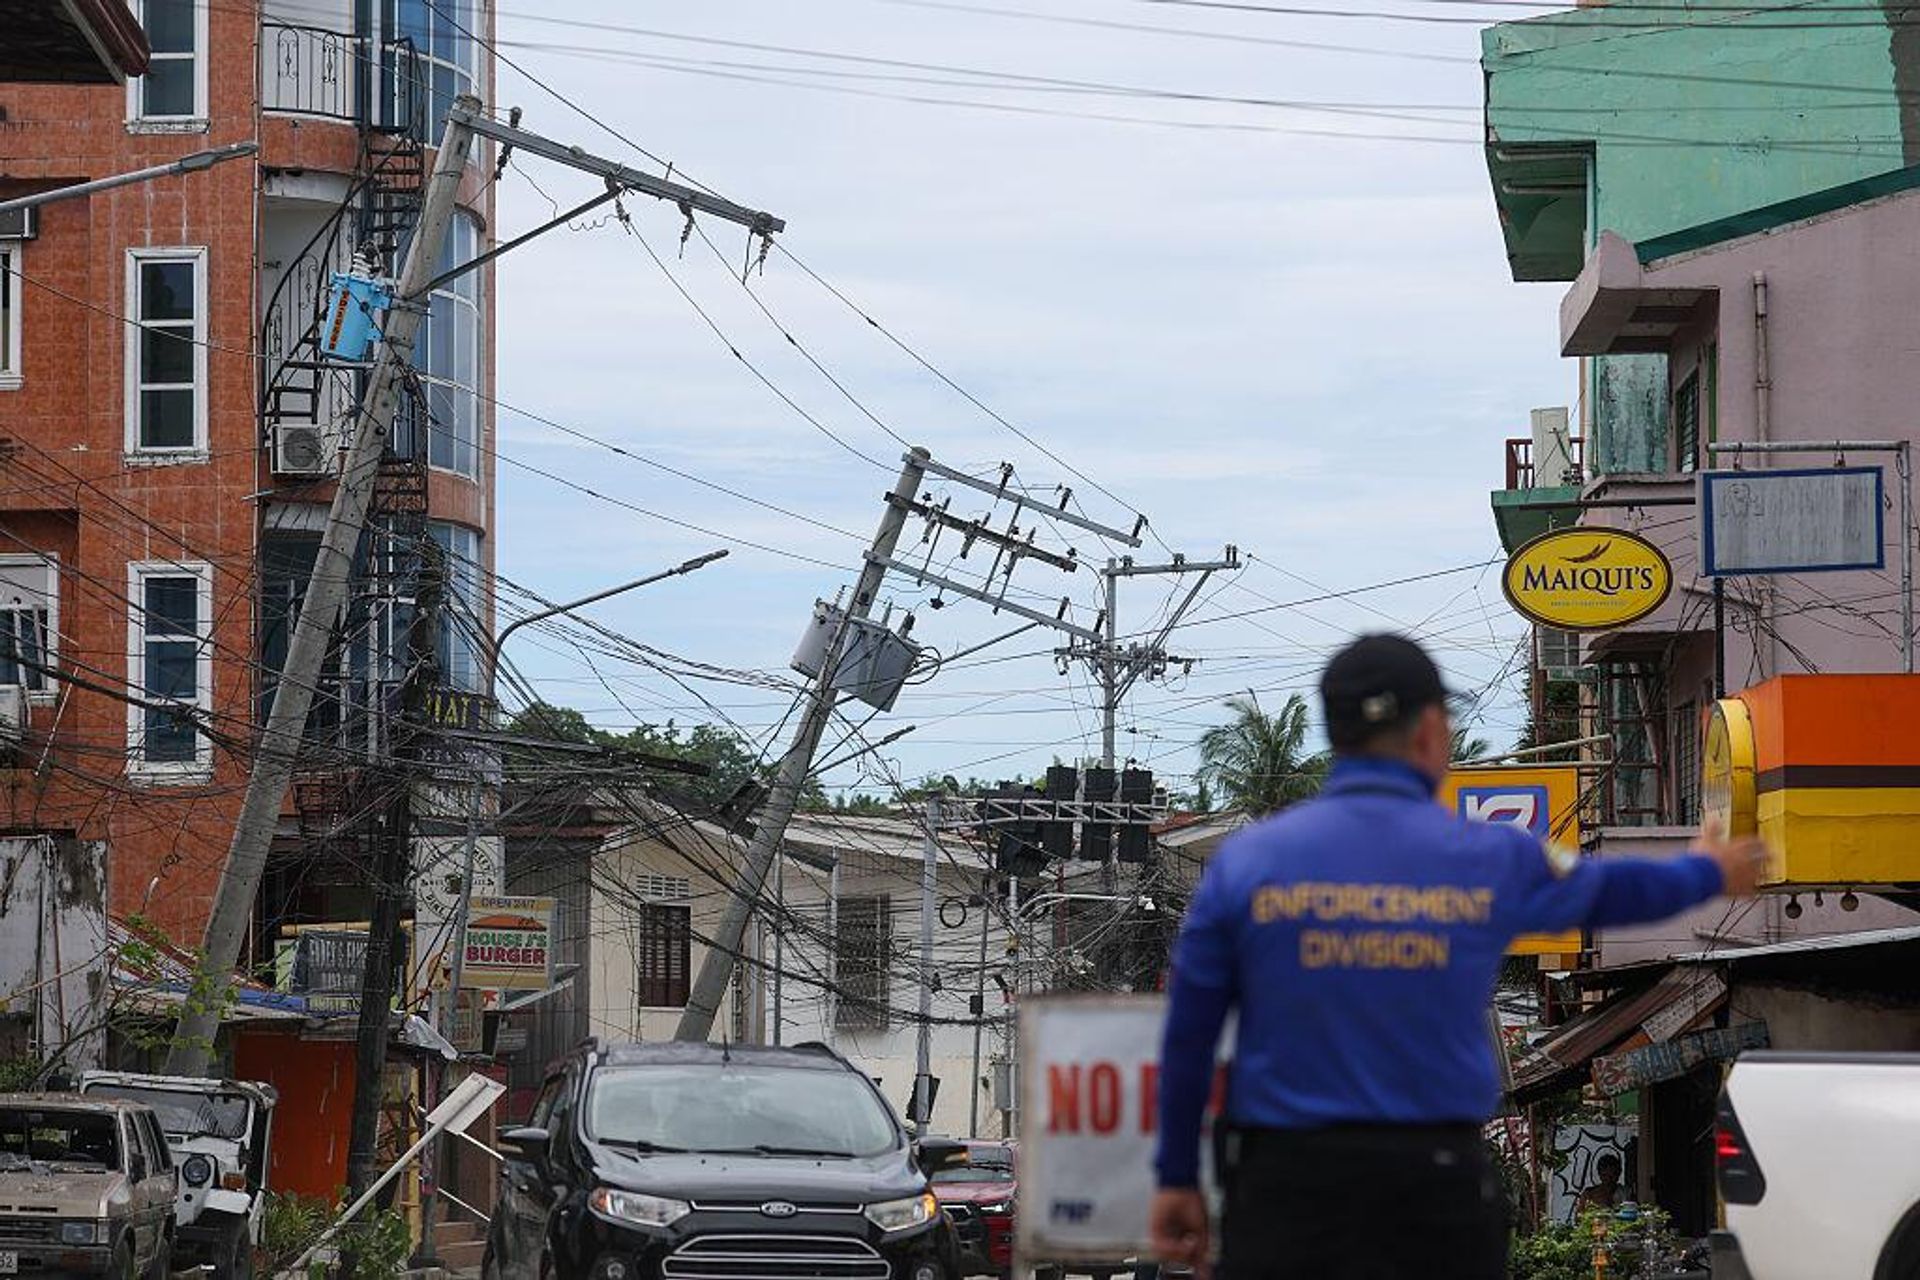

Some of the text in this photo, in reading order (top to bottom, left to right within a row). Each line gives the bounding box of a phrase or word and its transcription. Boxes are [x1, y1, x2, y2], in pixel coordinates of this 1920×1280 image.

[1522, 564, 1653, 595] MAIQUI'S
[481, 898, 511, 908] OPEN
[1252, 883, 1492, 923] ENFORCEMENT
[466, 946, 545, 964] BURGER
[467, 932, 523, 947] HOUSE
[1300, 930, 1448, 968] DIVISION
[1047, 1061, 1122, 1136] NO
